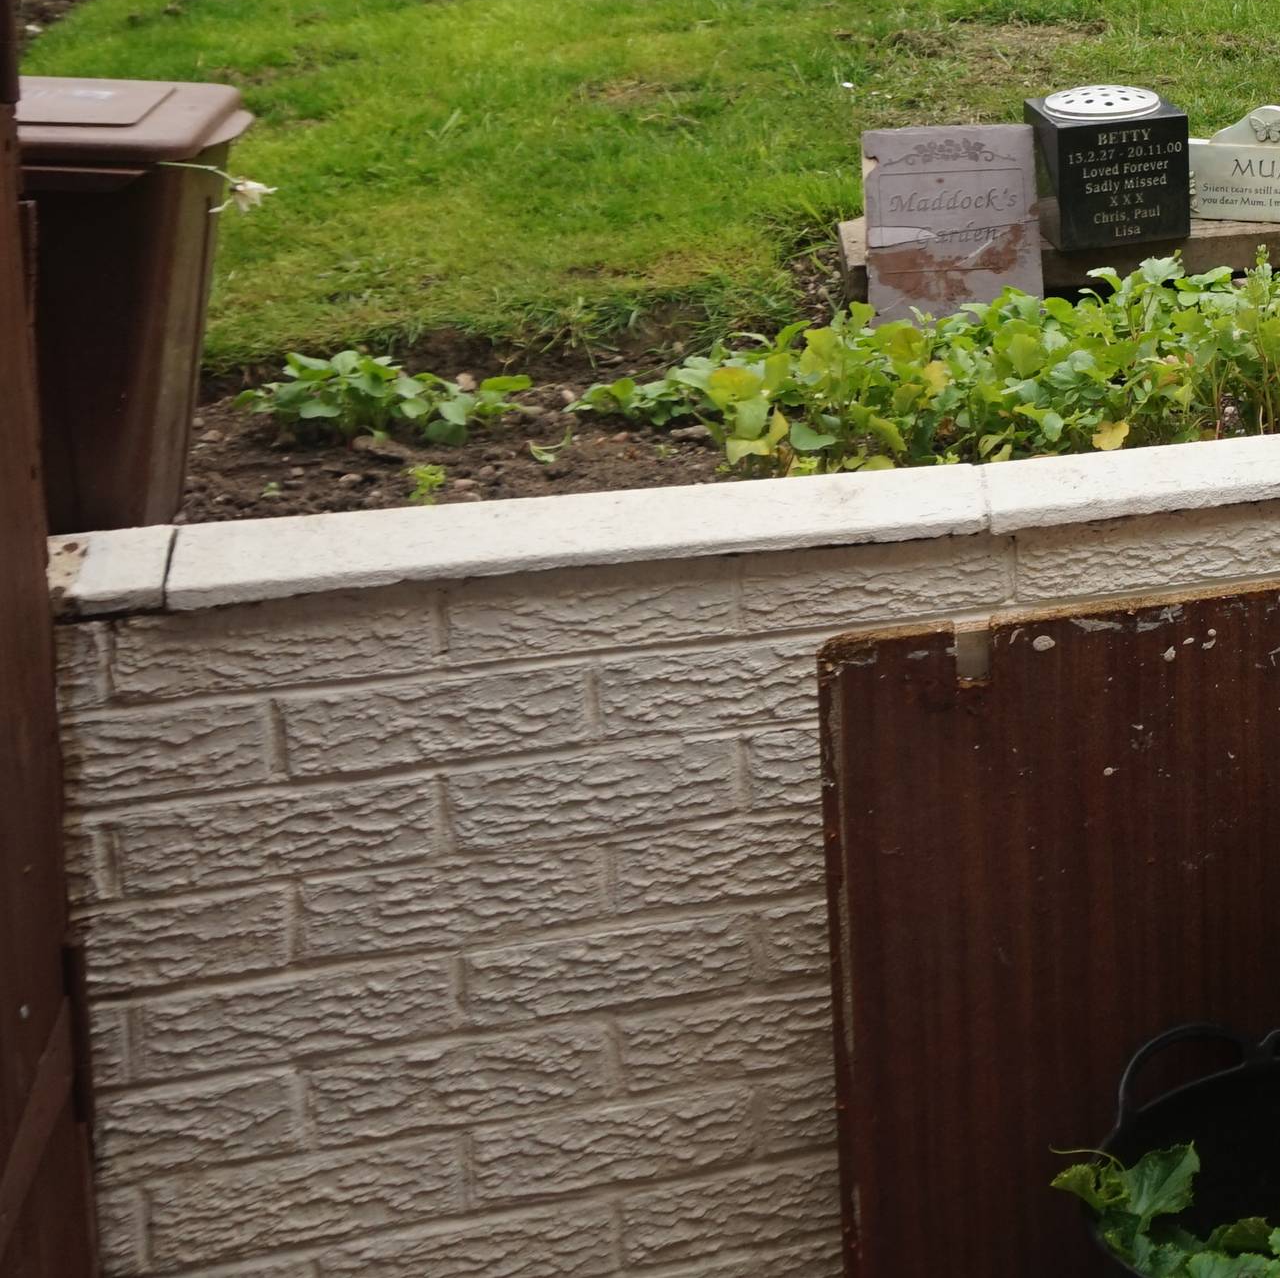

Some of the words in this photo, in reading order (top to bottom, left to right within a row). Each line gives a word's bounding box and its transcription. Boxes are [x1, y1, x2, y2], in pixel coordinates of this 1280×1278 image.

[1097, 128, 1152, 146] BETTY
[1068, 149, 1116, 165] 13.2.27
[1127, 141, 1182, 159] 20.11.00
[1082, 163, 1119, 179] Loved
[1123, 159, 1169, 175] Forever
[1085, 180, 1120, 195] Sadly
[1124, 174, 1168, 190] Missed
[1202, 183, 1229, 193] Silent
[1231, 186, 1253, 194] tears
[1254, 186, 1272, 195] still
[888, 187, 1018, 213] Maddock's
[1201, 197, 1218, 206] you
[1219, 196, 1238, 206] dear
[1134, 205, 1161, 220] Paul
[1115, 225, 1141, 237] Lisa
